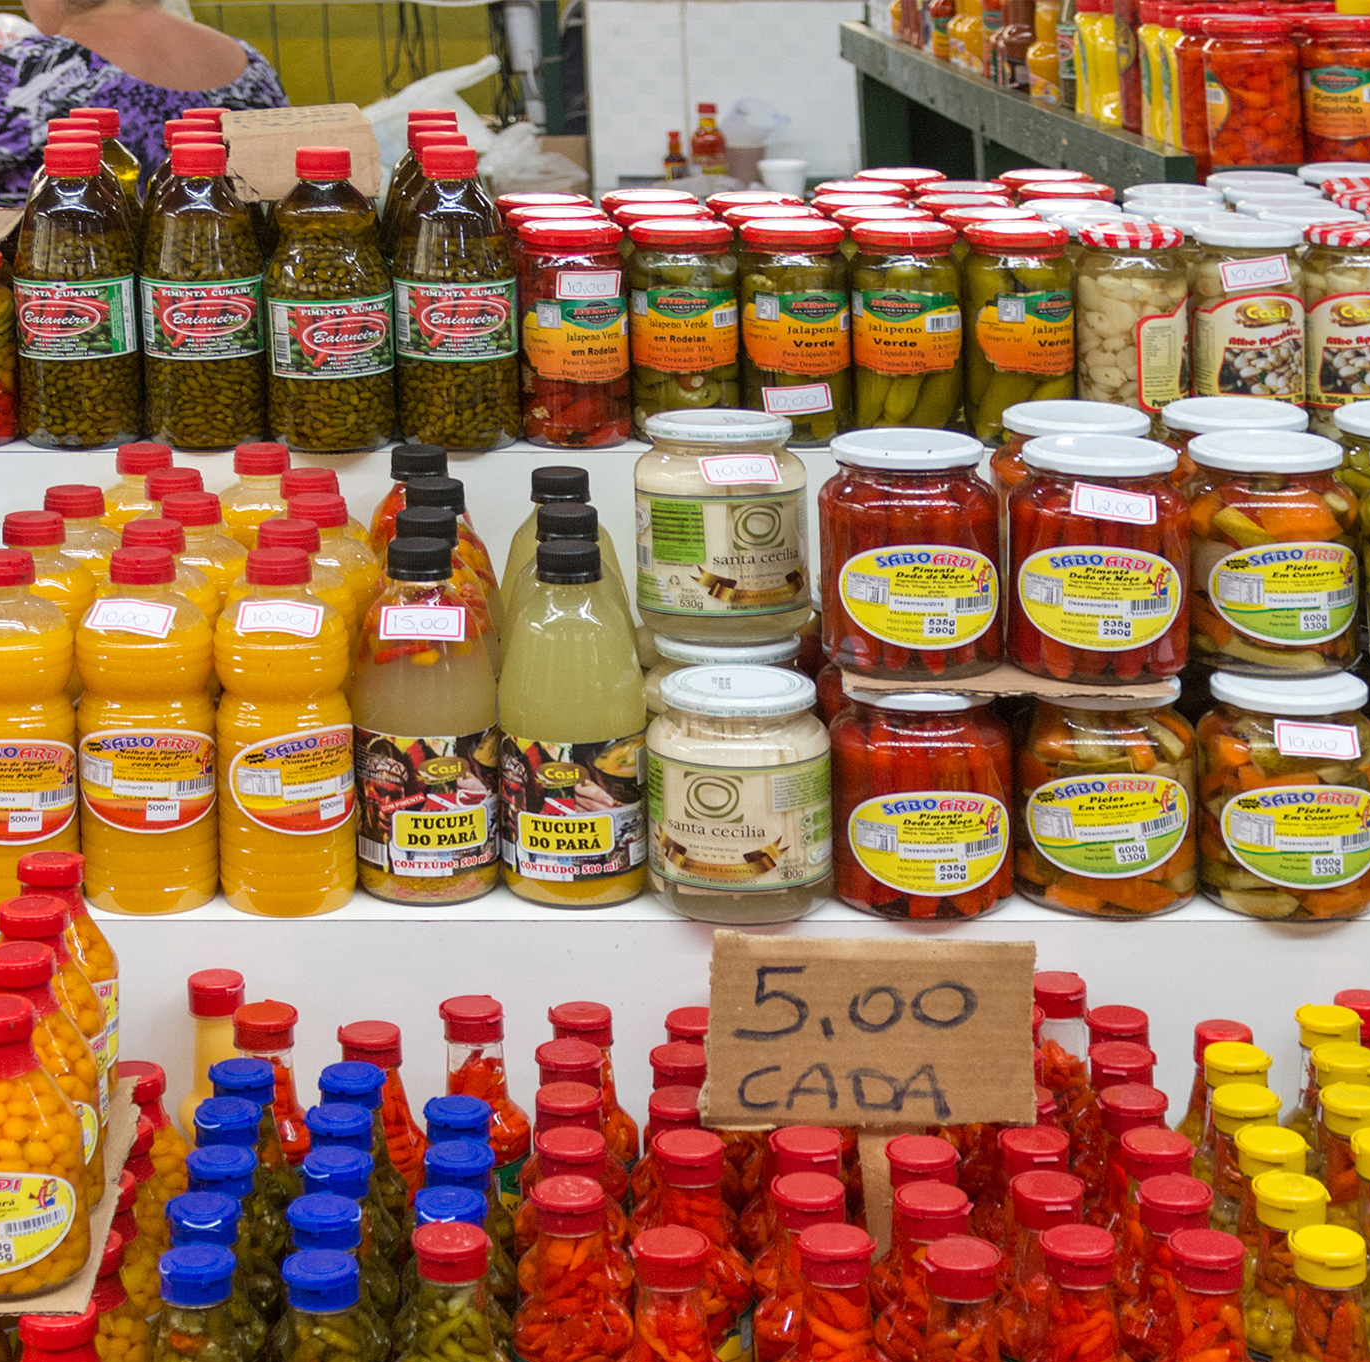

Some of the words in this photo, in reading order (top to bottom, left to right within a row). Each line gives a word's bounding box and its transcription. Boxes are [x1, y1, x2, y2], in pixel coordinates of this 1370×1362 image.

[56, 289, 99, 298] CUMARI
[161, 288, 205, 298] PIMENTA
[208, 288, 250, 298] CUMARI
[1247, 304, 1285, 319] Casi
[173, 311, 244, 326] Baianeira
[430, 311, 499, 326] Baianeira
[313, 328, 380, 344] Baianeira
[668, 334, 706, 343] Rodelas
[793, 338, 835, 349] Verde
[873, 337, 917, 348] Verde
[1038, 338, 1071, 348] Verde
[585, 346, 618, 356] Rodelas
[712, 553, 755, 566] santa
[761, 547, 799, 563] cecilia
[680, 599, 704, 610] 530g
[928, 618, 956, 628] 535g
[1103, 619, 1131, 629] 535g
[1302, 614, 1328, 623] 600g
[1302, 621, 1328, 631] 330g
[928, 627, 956, 637] 290g
[1102, 628, 1131, 638] 290g
[428, 762, 463, 776] Casi
[148, 803, 178, 812] 500ml
[320, 799, 343, 811] 500ml
[10, 815, 40, 824] 500ml
[411, 816, 474, 830] TUCUPI
[532, 820, 596, 834] TUCUPI
[668, 820, 701, 836] santa
[705, 824, 766, 838] cecilia
[408, 834, 431, 846] DO
[436, 827, 477, 844] PARÁ
[530, 837, 552, 849] DO
[559, 833, 601, 850] PARÁ
[394, 857, 458, 870] CONTEÚDO:
[461, 856, 479, 868] 500
[1314, 857, 1342, 866] 600g
[939, 864, 967, 874] 535g
[1314, 865, 1342, 874] 330g
[939, 872, 967, 881] 290g
[755, 966, 980, 1043] 5,00
[737, 1061, 953, 1118] CADA
